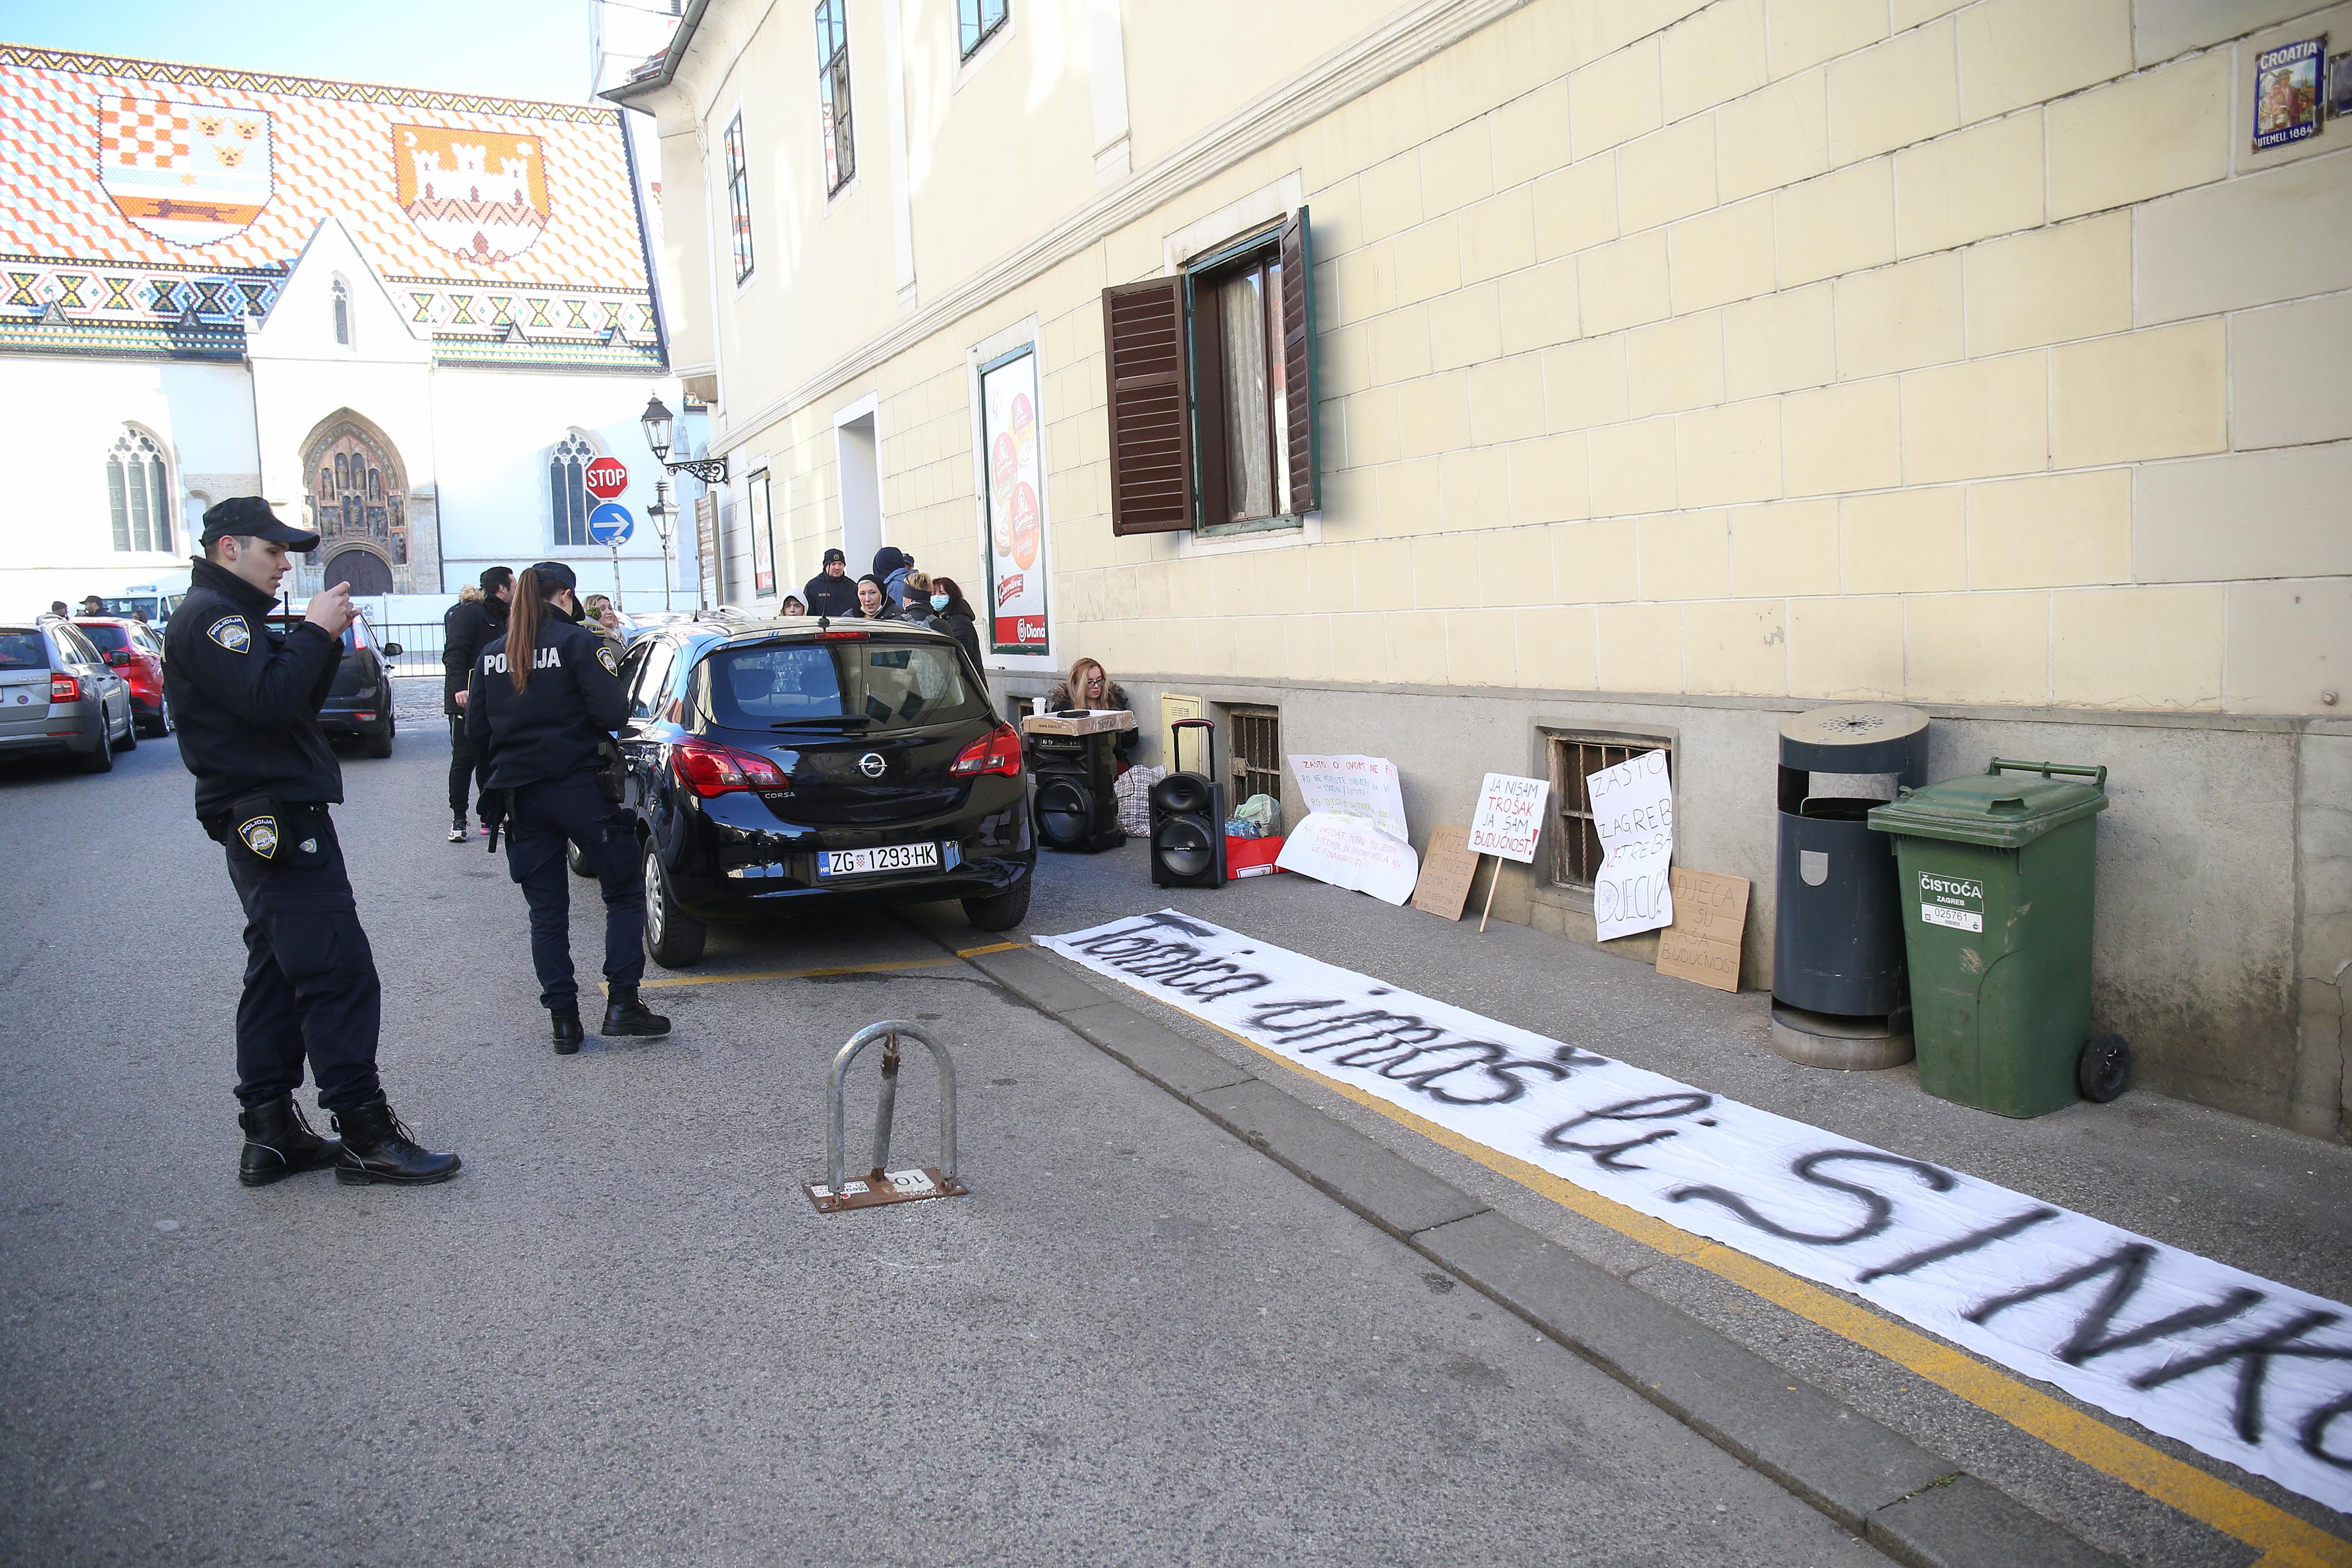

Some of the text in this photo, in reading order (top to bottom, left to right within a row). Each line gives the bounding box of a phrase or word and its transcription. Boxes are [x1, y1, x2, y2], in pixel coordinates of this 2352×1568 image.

[2260, 42, 2317, 70] CROATIA
[2289, 126, 2312, 139] 1884
[588, 469, 625, 487] STOP
[211, 618, 242, 635] POLICIJA
[485, 647, 561, 675] POIJA
[1303, 759, 1327, 768] ZAŠTO
[1370, 765, 1378, 773] NE
[1489, 778, 1538, 798] JA NISAM
[1489, 797, 1534, 817] TROŠAK
[242, 820, 273, 834] POLICIJA
[1482, 814, 1528, 835] JA SAM
[1599, 799, 1672, 838] ZAGREB
[1474, 829, 1539, 855] BUDUĆNOST!
[831, 852, 853, 873] ZG
[1425, 853, 1472, 876] NE MOŽETE
[1676, 875, 1735, 908] DJECA
[1921, 874, 1982, 898] ČISTOĆA
[1599, 869, 1666, 924] DJECU?
[1936, 895, 1965, 906] ZAGREB
[1694, 908, 1713, 927] SU
[1935, 908, 1967, 922] 025761
[1674, 927, 1709, 947] AŠA
[1068, 911, 1274, 1003] Tomica
[1539, 1092, 1718, 1172] li
